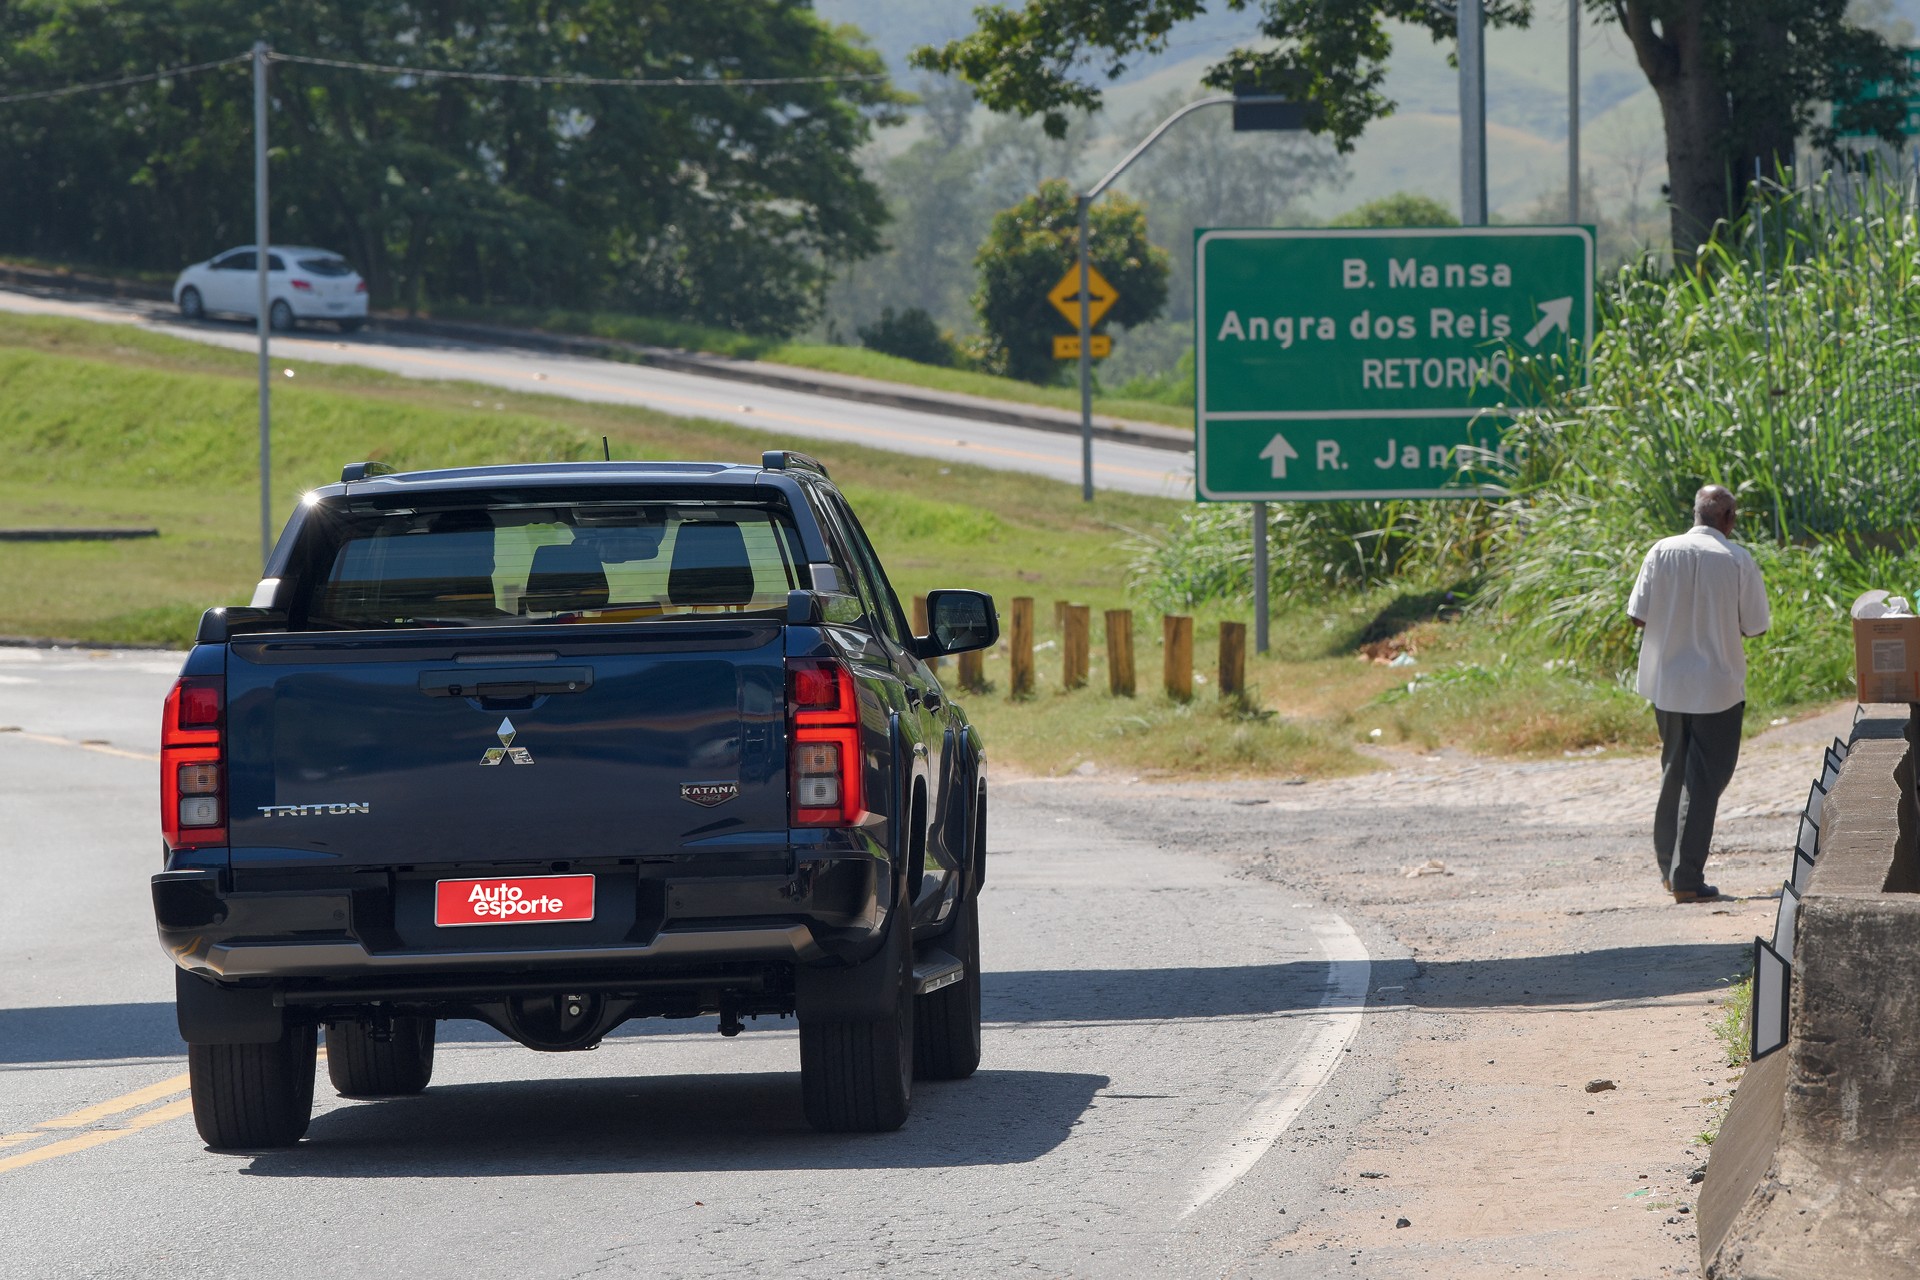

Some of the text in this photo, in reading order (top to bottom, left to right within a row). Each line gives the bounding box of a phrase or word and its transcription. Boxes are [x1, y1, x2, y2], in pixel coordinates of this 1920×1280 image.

[1342, 258, 1512, 289] B. Mansa
[1217, 307, 1512, 349] Angra dos Reis
[1362, 356, 1511, 389] RETORNO
[1316, 440, 1349, 470] R.
[682, 785, 738, 795] KATANA
[257, 802, 369, 818] TRITON
[467, 883, 523, 902] Auto
[473, 895, 564, 919] esporte
